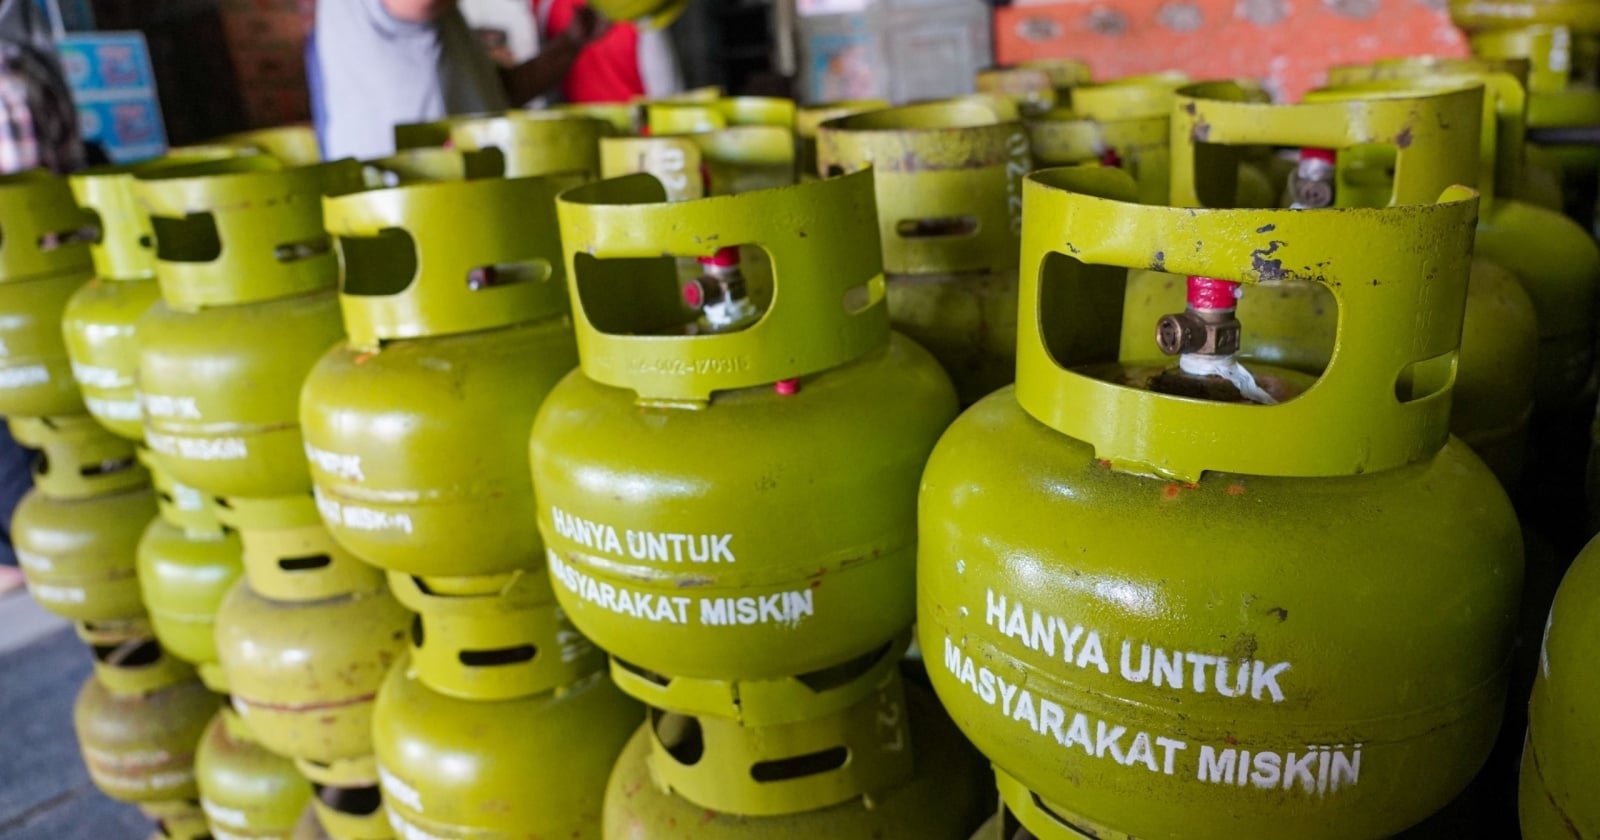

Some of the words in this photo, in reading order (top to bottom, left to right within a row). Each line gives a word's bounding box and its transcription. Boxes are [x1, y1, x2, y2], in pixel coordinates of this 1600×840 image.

[552, 506, 623, 556] HANYA
[626, 530, 735, 563] UNTUK
[547, 548, 691, 624] MASYARAKAT
[700, 588, 814, 627] MISKIN
[985, 586, 1109, 674] HANYA
[1119, 640, 1292, 702] UNTUK
[944, 637, 1188, 775] MASYARAKAT
[1197, 742, 1363, 797] MISKIN
